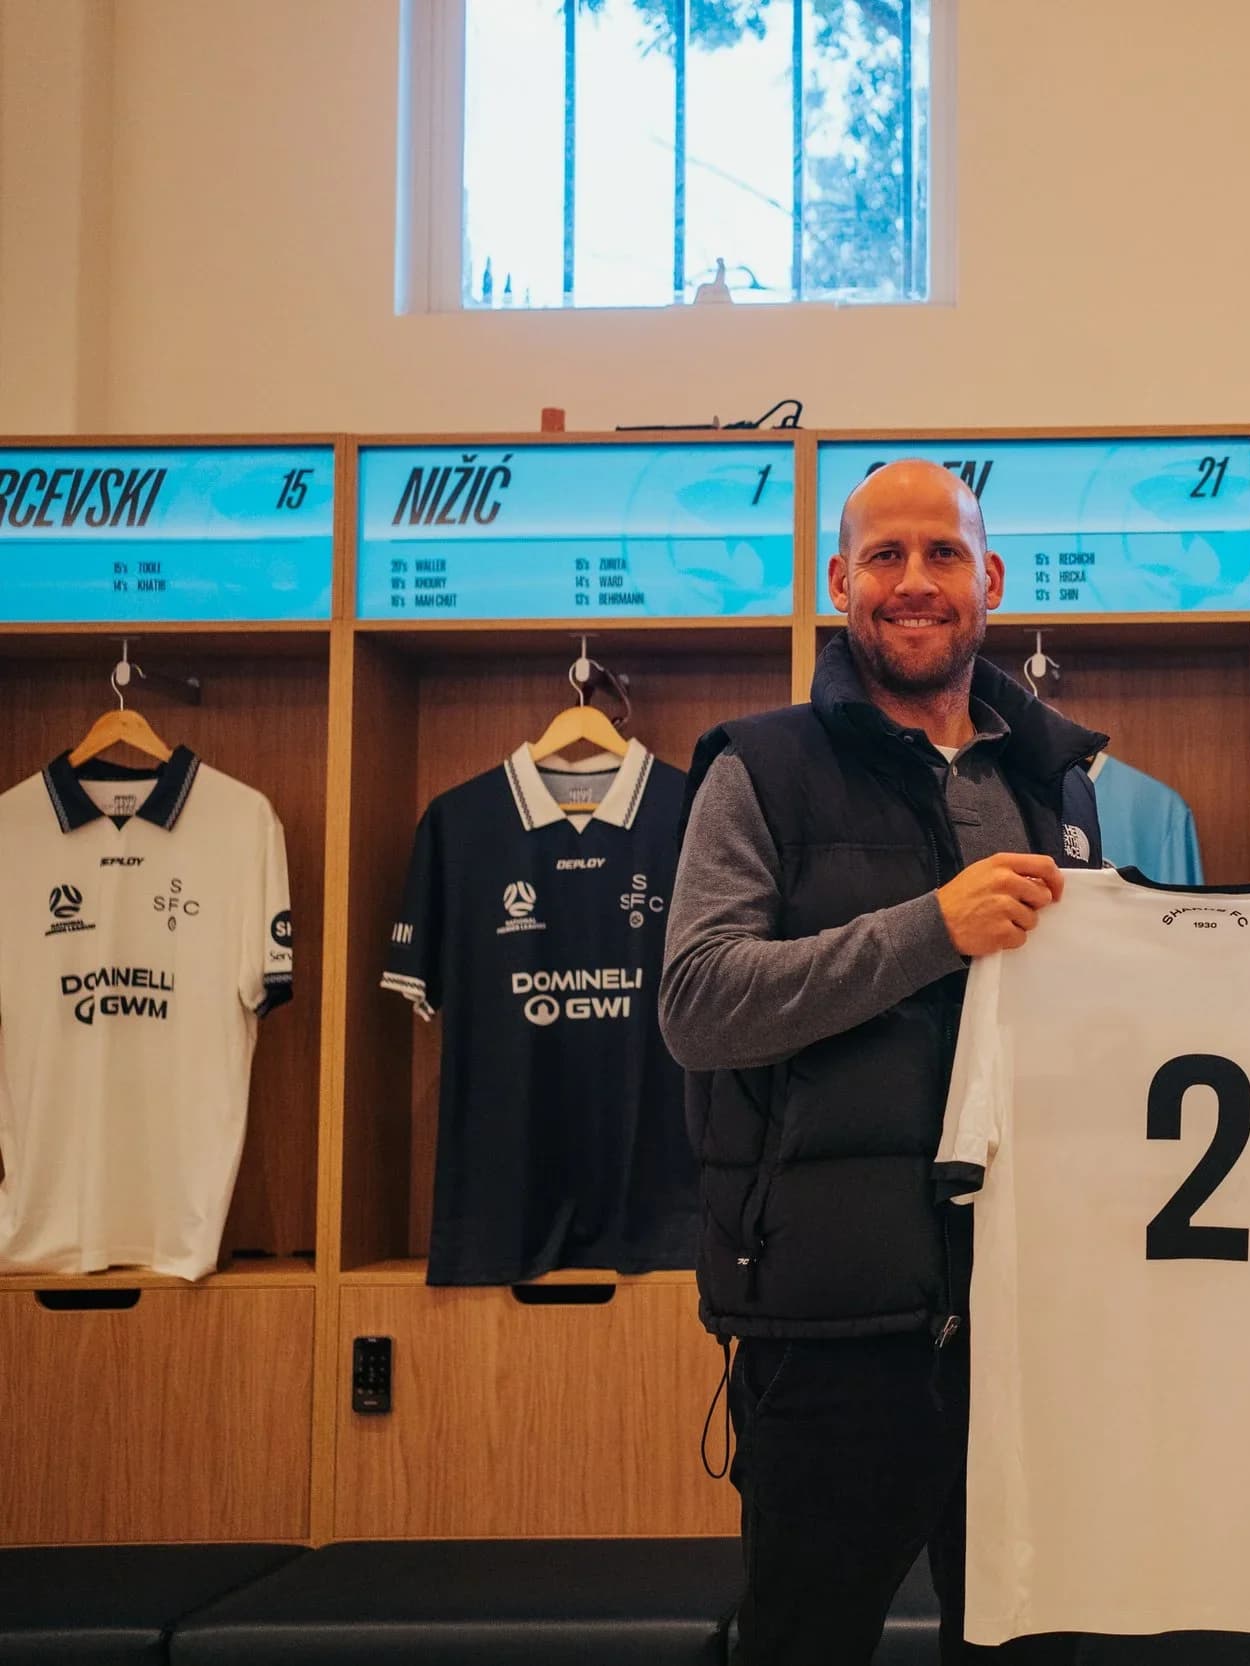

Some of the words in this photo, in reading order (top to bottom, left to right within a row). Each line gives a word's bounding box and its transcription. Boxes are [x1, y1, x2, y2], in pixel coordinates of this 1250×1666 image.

[276, 468, 314, 509] 15
[392, 453, 513, 525] NIŽIĆ
[752, 464, 772, 505] 1
[1190, 457, 1230, 498] 21
[0, 468, 167, 527] RCEVSKI
[599, 576, 622, 587] WARD
[1060, 589, 1079, 600] SHIN
[557, 858, 606, 870] DEPLOY
[1230, 910, 1248, 927] FC
[100, 995, 167, 1019] GWM
